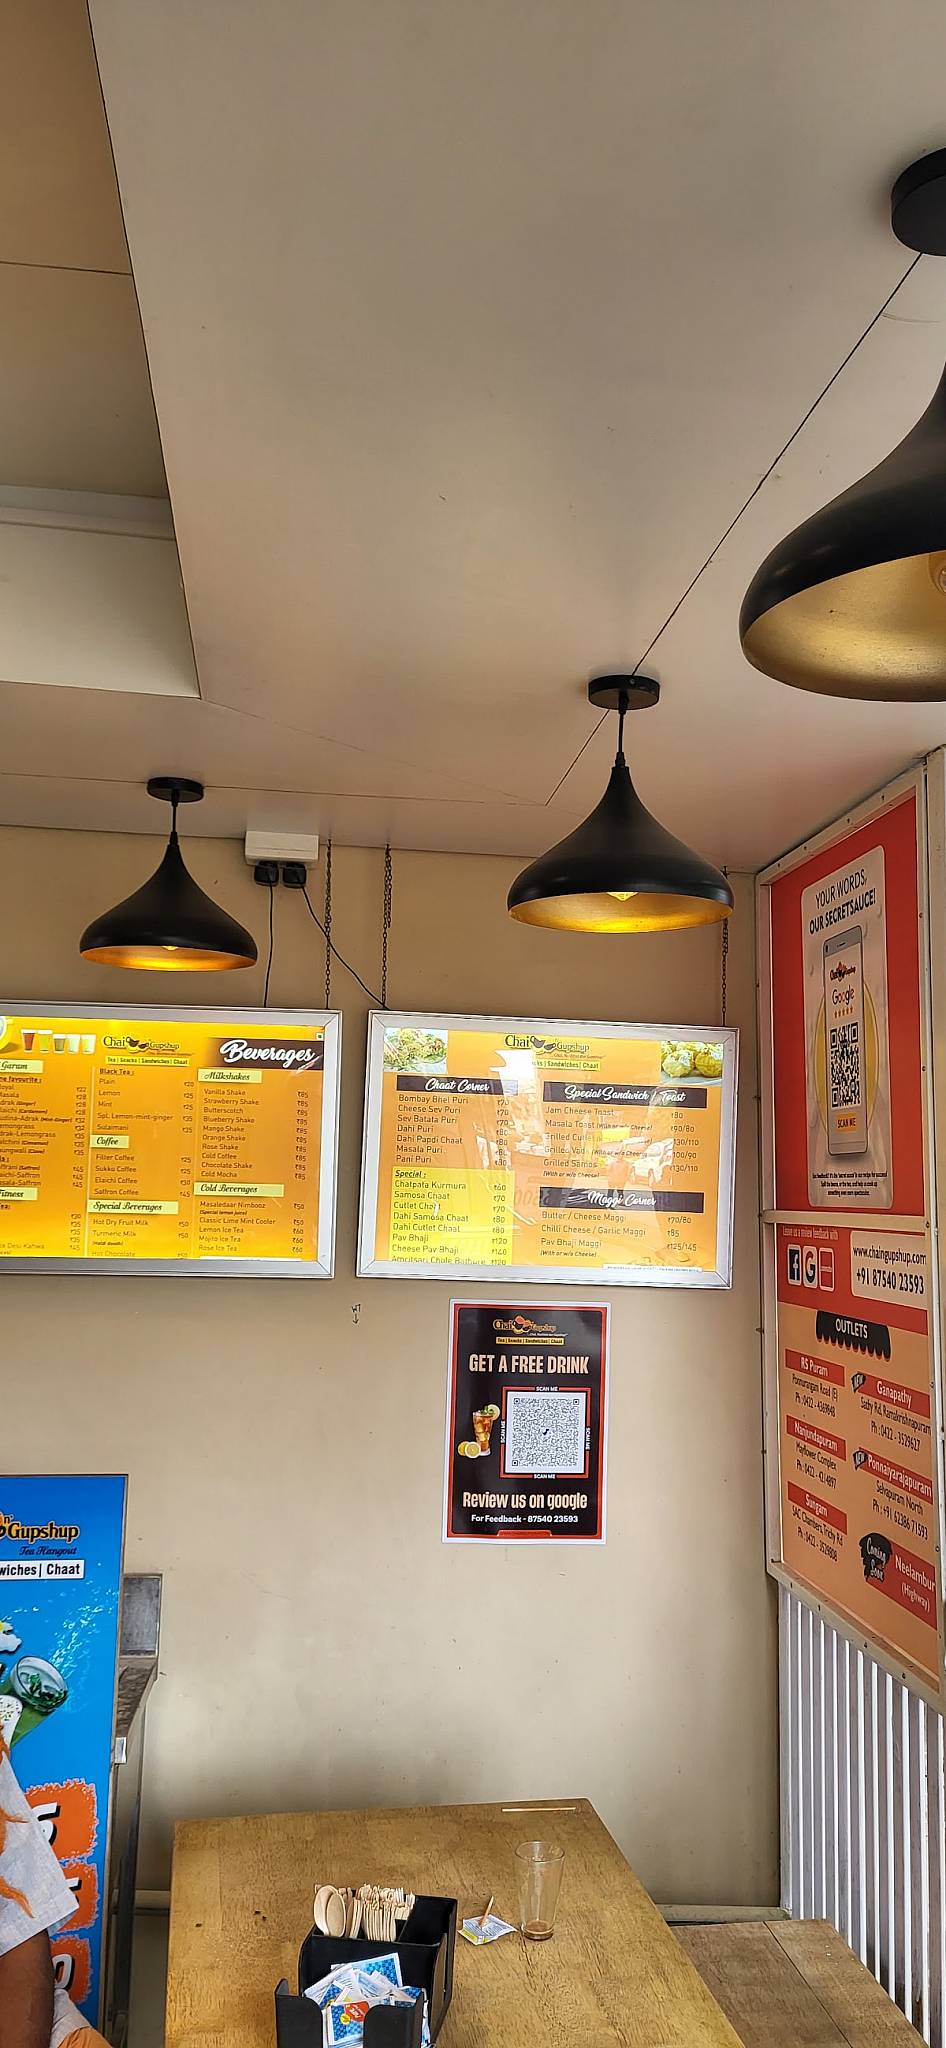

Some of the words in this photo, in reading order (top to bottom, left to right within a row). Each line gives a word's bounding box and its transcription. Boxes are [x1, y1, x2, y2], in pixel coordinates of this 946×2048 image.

[815, 885, 836, 910] YOUR
[836, 868, 868, 898] WORDS,
[809, 915, 825, 935] OUR
[832, 984, 855, 1005] Google
[103, 1036, 126, 1048] Chai
[505, 1035, 530, 1047] Chai
[556, 1041, 590, 1053] Gupshup
[220, 1040, 315, 1068] Beverages
[204, 1072, 250, 1081] Milkshakes
[425, 1078, 457, 1091] Chaat
[457, 1079, 490, 1092] Corner
[399, 1094, 431, 1104] Bombay
[564, 1084, 602, 1100] Special
[601, 1086, 650, 1102] Sandwich
[659, 1089, 687, 1102] Toast
[204, 1098, 238, 1107] Strawberry
[398, 1105, 427, 1113] Cheese
[444, 1106, 461, 1114] Puri
[545, 1106, 562, 1114] Jam
[563, 1107, 592, 1115] Cheese
[203, 1116, 234, 1124] Blueberry
[545, 1120, 573, 1128] Masala
[837, 1118, 849, 1129] SCAN
[849, 1117, 857, 1127] ME
[203, 1125, 224, 1133] Mango
[417, 1125, 434, 1133] Puri
[97, 1136, 119, 1146] Coffee
[440, 1136, 463, 1144] Chaat
[544, 1132, 570, 1141] Grilled
[396, 1145, 424, 1153] Masala
[426, 1145, 443, 1153] Puri
[543, 1159, 570, 1167] Grilled
[395, 1169, 422, 1178] Special
[201, 1184, 217, 1192] Cold
[218, 1184, 258, 1194] Beverages
[395, 1180, 430, 1189] Chatpata
[431, 1181, 467, 1189] Kurmura
[394, 1191, 426, 1199] Samosa
[588, 1191, 623, 1207] Maggi
[623, 1194, 657, 1207] Corner
[93, 1202, 121, 1211] Special
[122, 1202, 162, 1212] Beverages
[393, 1201, 417, 1209] Cutlet
[393, 1212, 411, 1220] Dahi
[413, 1213, 444, 1221] Samosa
[446, 1214, 469, 1222] Chaat
[541, 1211, 567, 1219] Butter
[573, 1212, 601, 1221] Cheese
[393, 1222, 411, 1230] Dahi
[412, 1223, 436, 1231] Cutlet
[563, 1225, 591, 1233] Cheese
[623, 1228, 646, 1237] Maggi
[408, 1234, 429, 1243] Bhaji
[392, 1244, 420, 1252] Cheese
[541, 1238, 555, 1246] Pav
[556, 1238, 577, 1248] Bhaji
[578, 1239, 602, 1248] Maggi
[666, 1243, 697, 1252] ₹125/145
[853, 1244, 927, 1267] www.chaingupshup.com
[856, 1269, 870, 1285] +91
[872, 1270, 897, 1290] 87540
[898, 1272, 925, 1295] 23593
[493, 1319, 512, 1331] Chai
[835, 1317, 869, 1339] OUTLETS
[469, 1353, 495, 1373] GET
[498, 1355, 508, 1373] A
[512, 1355, 543, 1374] FREE
[547, 1356, 589, 1374] DRINK
[800, 1356, 809, 1370] RS
[809, 1359, 829, 1377] Puram
[877, 1380, 912, 1409] Ganapathy
[870, 1420, 878, 1434] Ph
[794, 1420, 838, 1452] Nanjundapuram
[817, 1451, 837, 1470] Complex
[463, 1491, 509, 1509] Review
[511, 1494, 527, 1509] us
[529, 1494, 545, 1509] on
[547, 1491, 588, 1511] google
[805, 1493, 828, 1517] Sungam
[872, 1498, 879, 1513] Ph
[905, 1494, 924, 1516] North
[471, 1514, 485, 1522] For
[485, 1514, 522, 1523] Feedback
[527, 1515, 552, 1523] 87540
[553, 1515, 579, 1523] 23593
[8, 1521, 79, 1543] Gupshup
[19, 1545, 35, 1556] Tea
[36, 1545, 78, 1557] Hangout
[866, 1536, 886, 1569] Coming
[47, 1563, 81, 1575] Chaat
[895, 1554, 936, 1592] Neelambur
[901, 1582, 930, 1613] (Highway)
